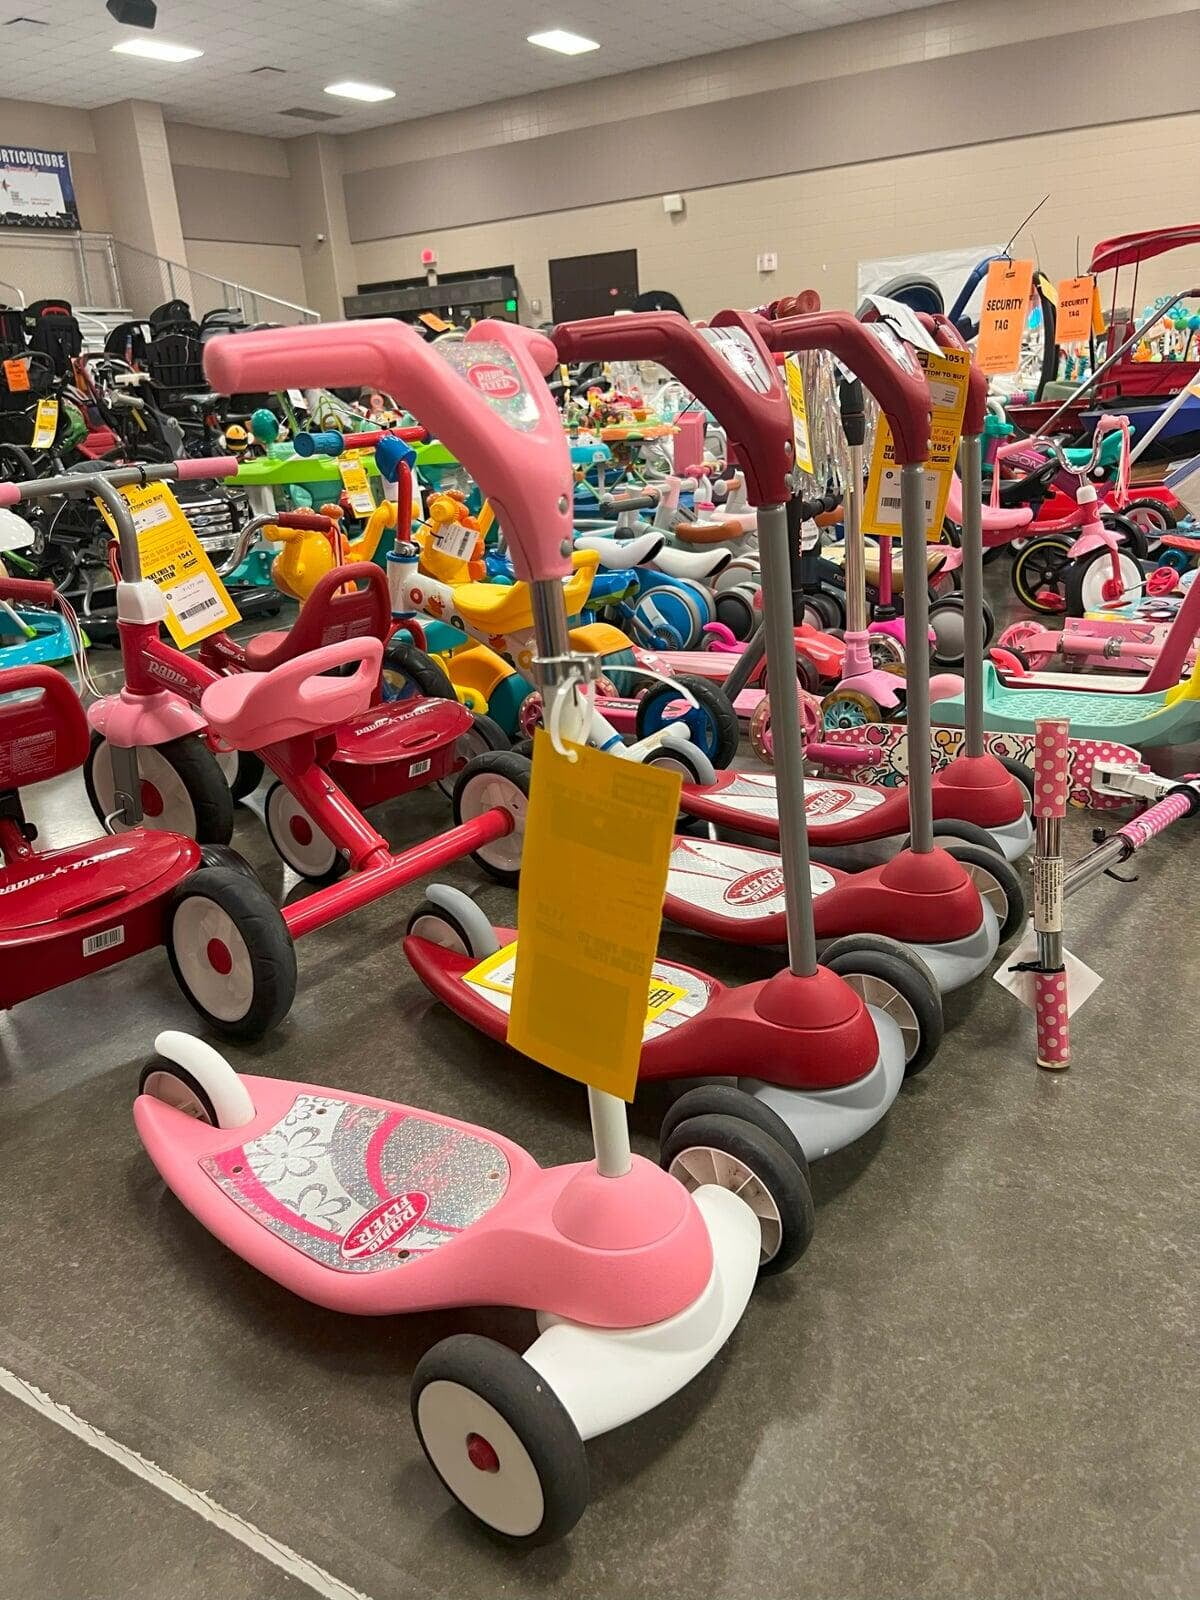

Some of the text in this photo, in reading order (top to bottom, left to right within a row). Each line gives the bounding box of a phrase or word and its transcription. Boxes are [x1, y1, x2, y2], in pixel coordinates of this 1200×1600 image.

[0, 148, 65, 168] RTICULTURE
[986, 298, 1024, 312] SECURITY
[1060, 297, 1089, 308] SECURITY
[994, 319, 1009, 331] TAG
[945, 354, 965, 364] 1051
[475, 370, 504, 381] RADIO
[479, 378, 513, 391] FLYER
[933, 444, 951, 452] 1051
[156, 567, 168, 576] THIS
[167, 563, 175, 571] TO
[147, 661, 188, 685] RADIO
[354, 717, 389, 736] RADIO
[820, 792, 848, 814] RADIO
[741, 868, 784, 896] FLYER
[354, 1195, 410, 1244] FLYER
[369, 1204, 417, 1252] RADIO
